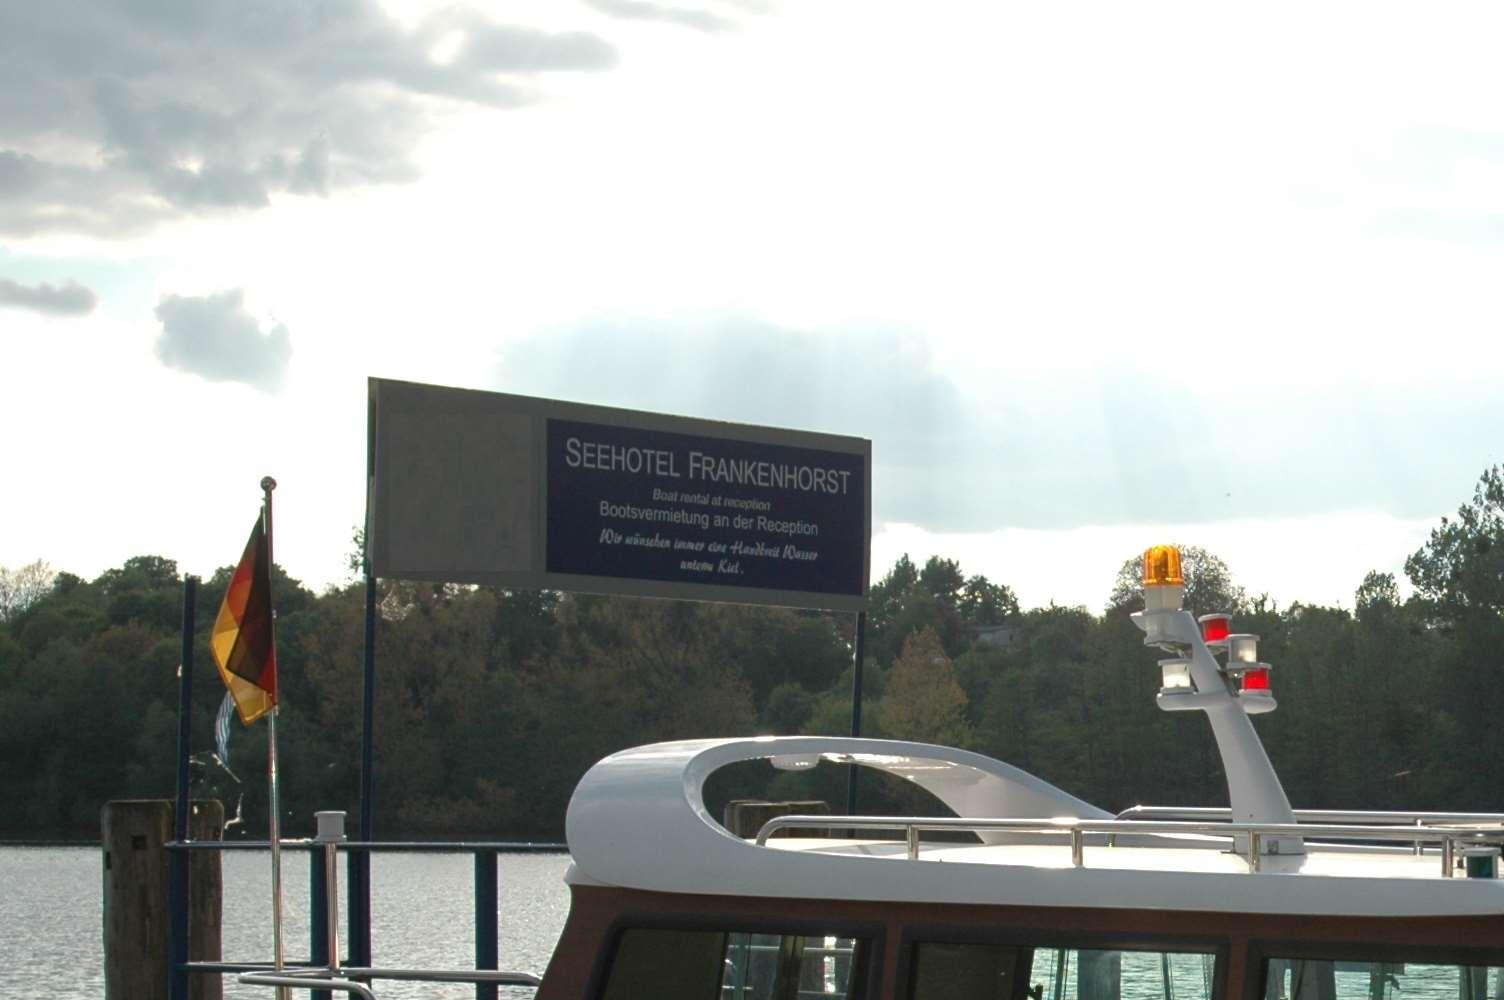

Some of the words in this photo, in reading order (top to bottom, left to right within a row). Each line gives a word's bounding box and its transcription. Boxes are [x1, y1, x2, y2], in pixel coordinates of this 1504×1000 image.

[565, 437, 680, 478] SEEHOTEL
[689, 451, 851, 494] FRANKENHORST
[652, 488, 678, 501] Boat
[711, 497, 722, 507] at
[600, 500, 709, 529] Bootsvermietung
[714, 515, 730, 528] an
[733, 516, 752, 530] der
[758, 517, 818, 536] Reception
